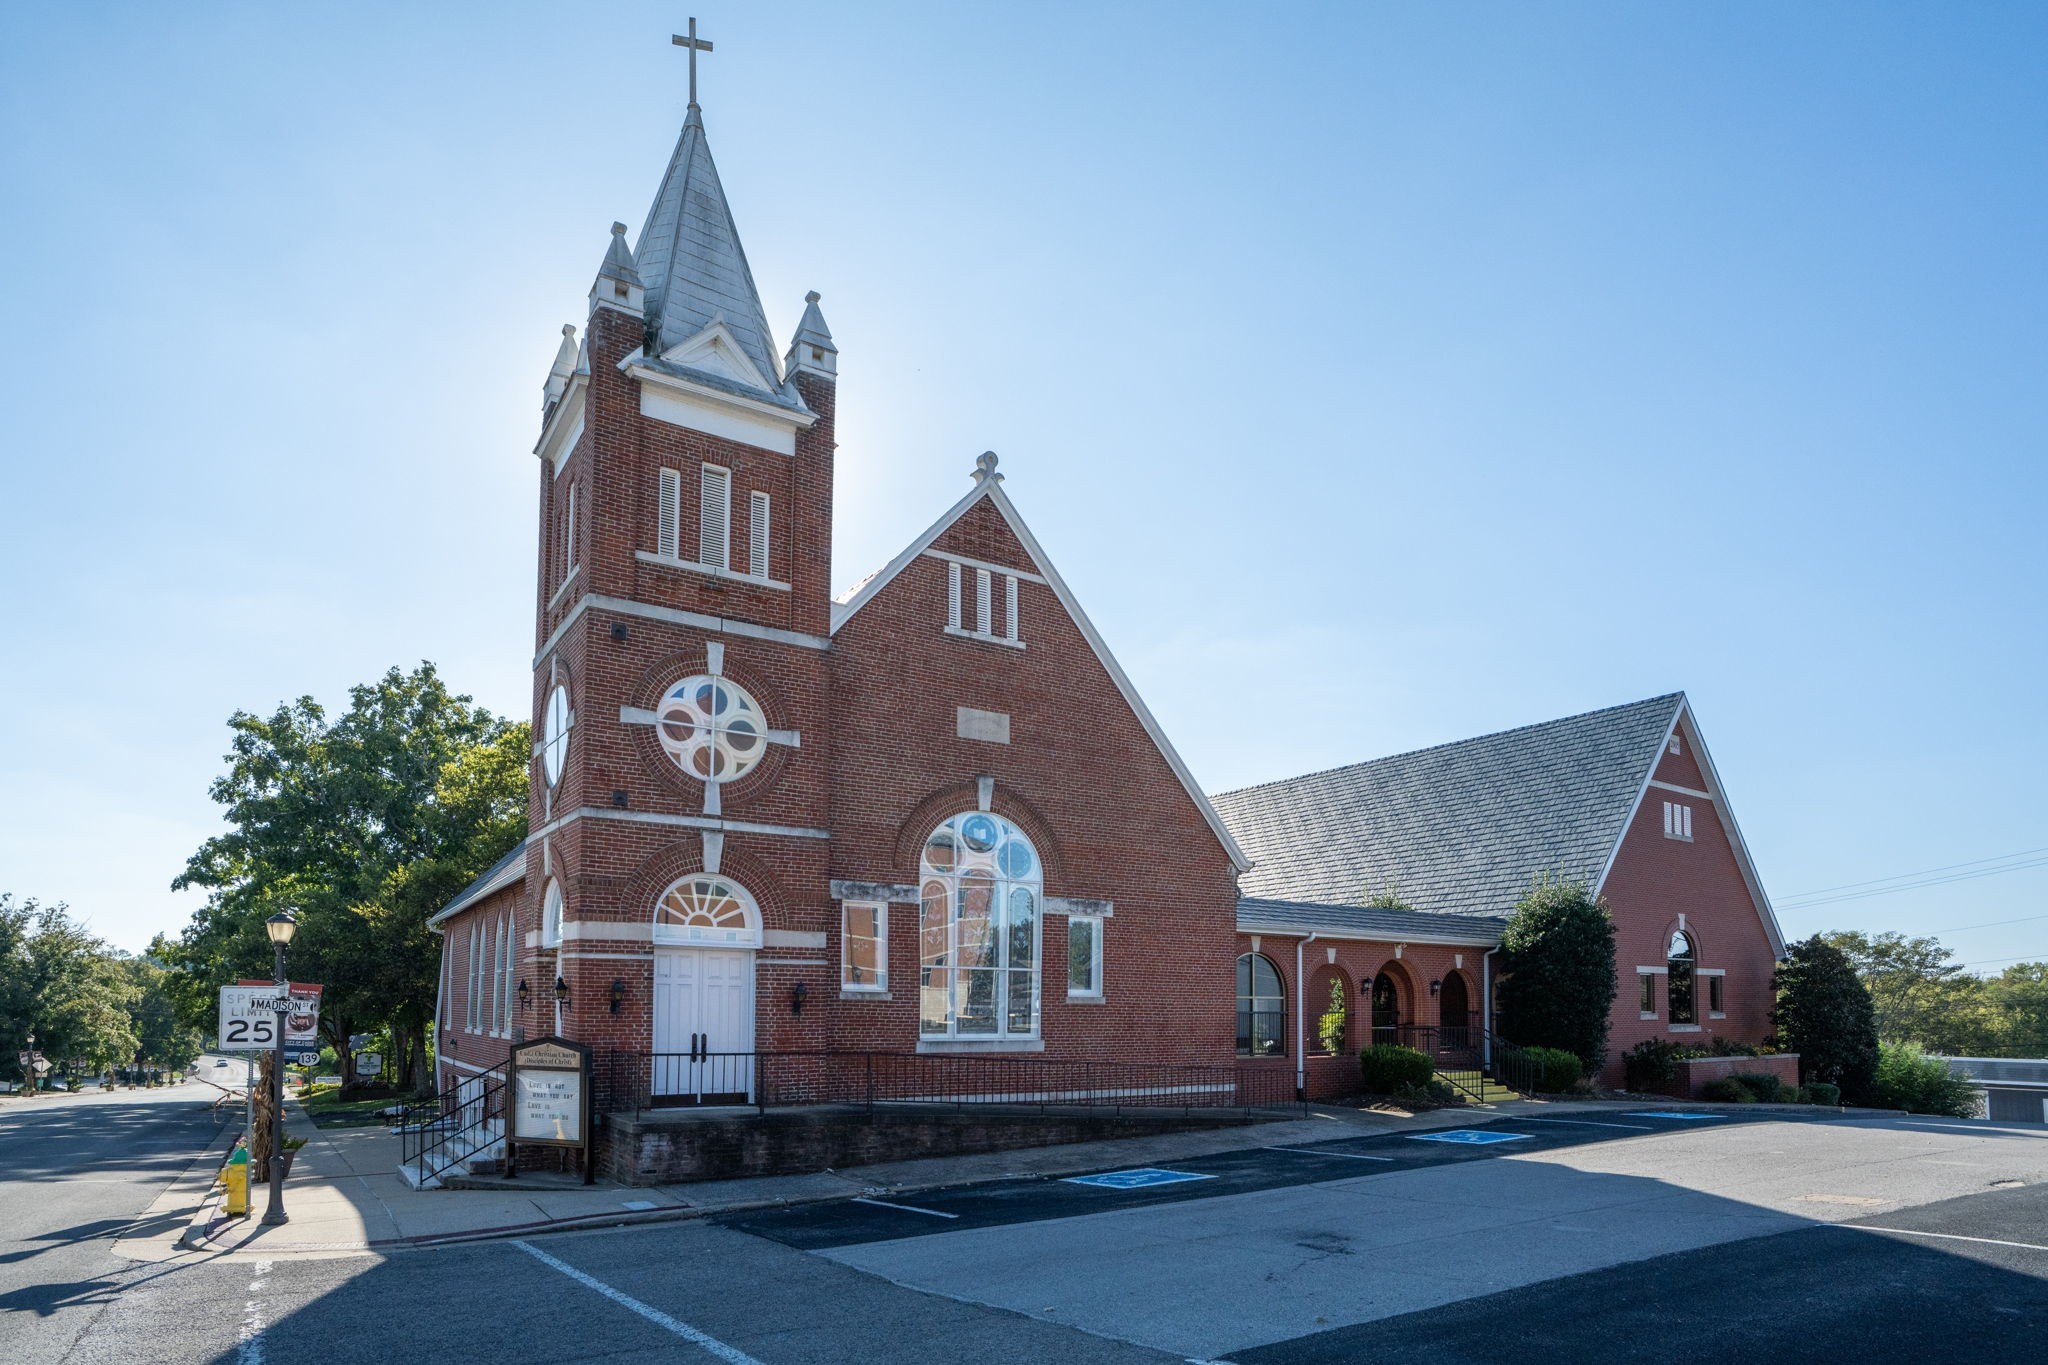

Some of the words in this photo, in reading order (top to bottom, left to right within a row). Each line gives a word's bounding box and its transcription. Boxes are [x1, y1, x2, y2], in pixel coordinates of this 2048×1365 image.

[256, 1000, 301, 1011] MADISON
[226, 1020, 272, 1042] 25
[301, 1054, 318, 1064] 139
